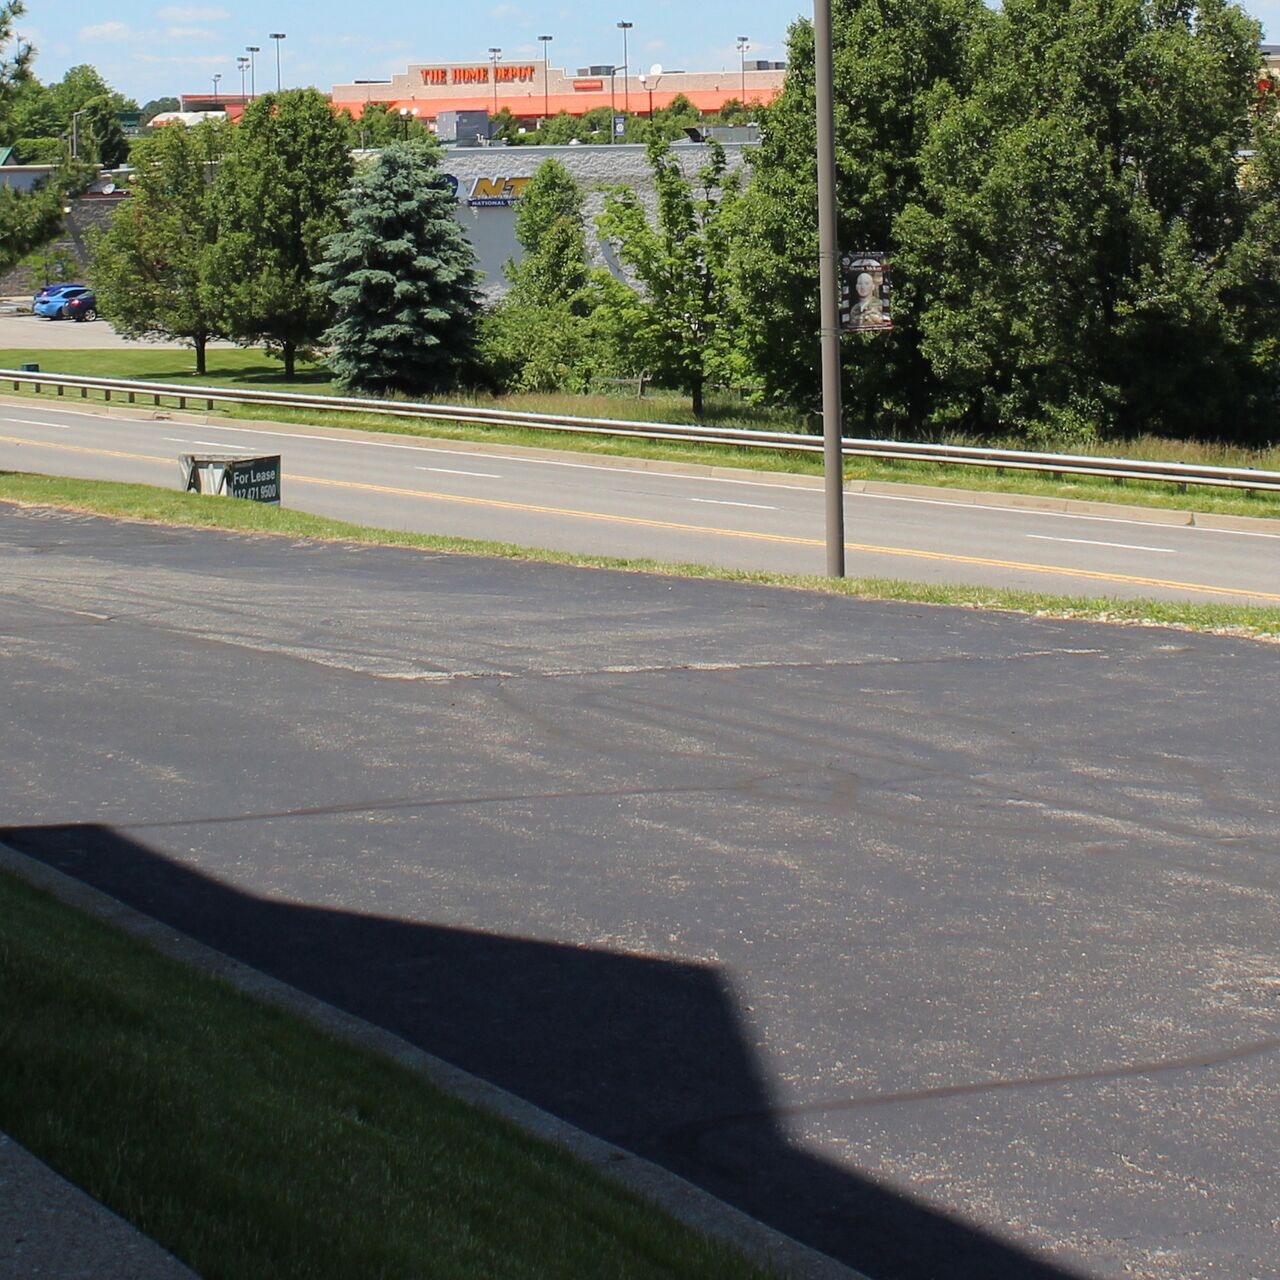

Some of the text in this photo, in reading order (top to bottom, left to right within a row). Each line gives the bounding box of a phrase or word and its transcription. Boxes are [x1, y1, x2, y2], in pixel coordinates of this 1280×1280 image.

[420, 66, 535, 83] THE HOME DEPOT
[233, 470, 276, 485] For Lease
